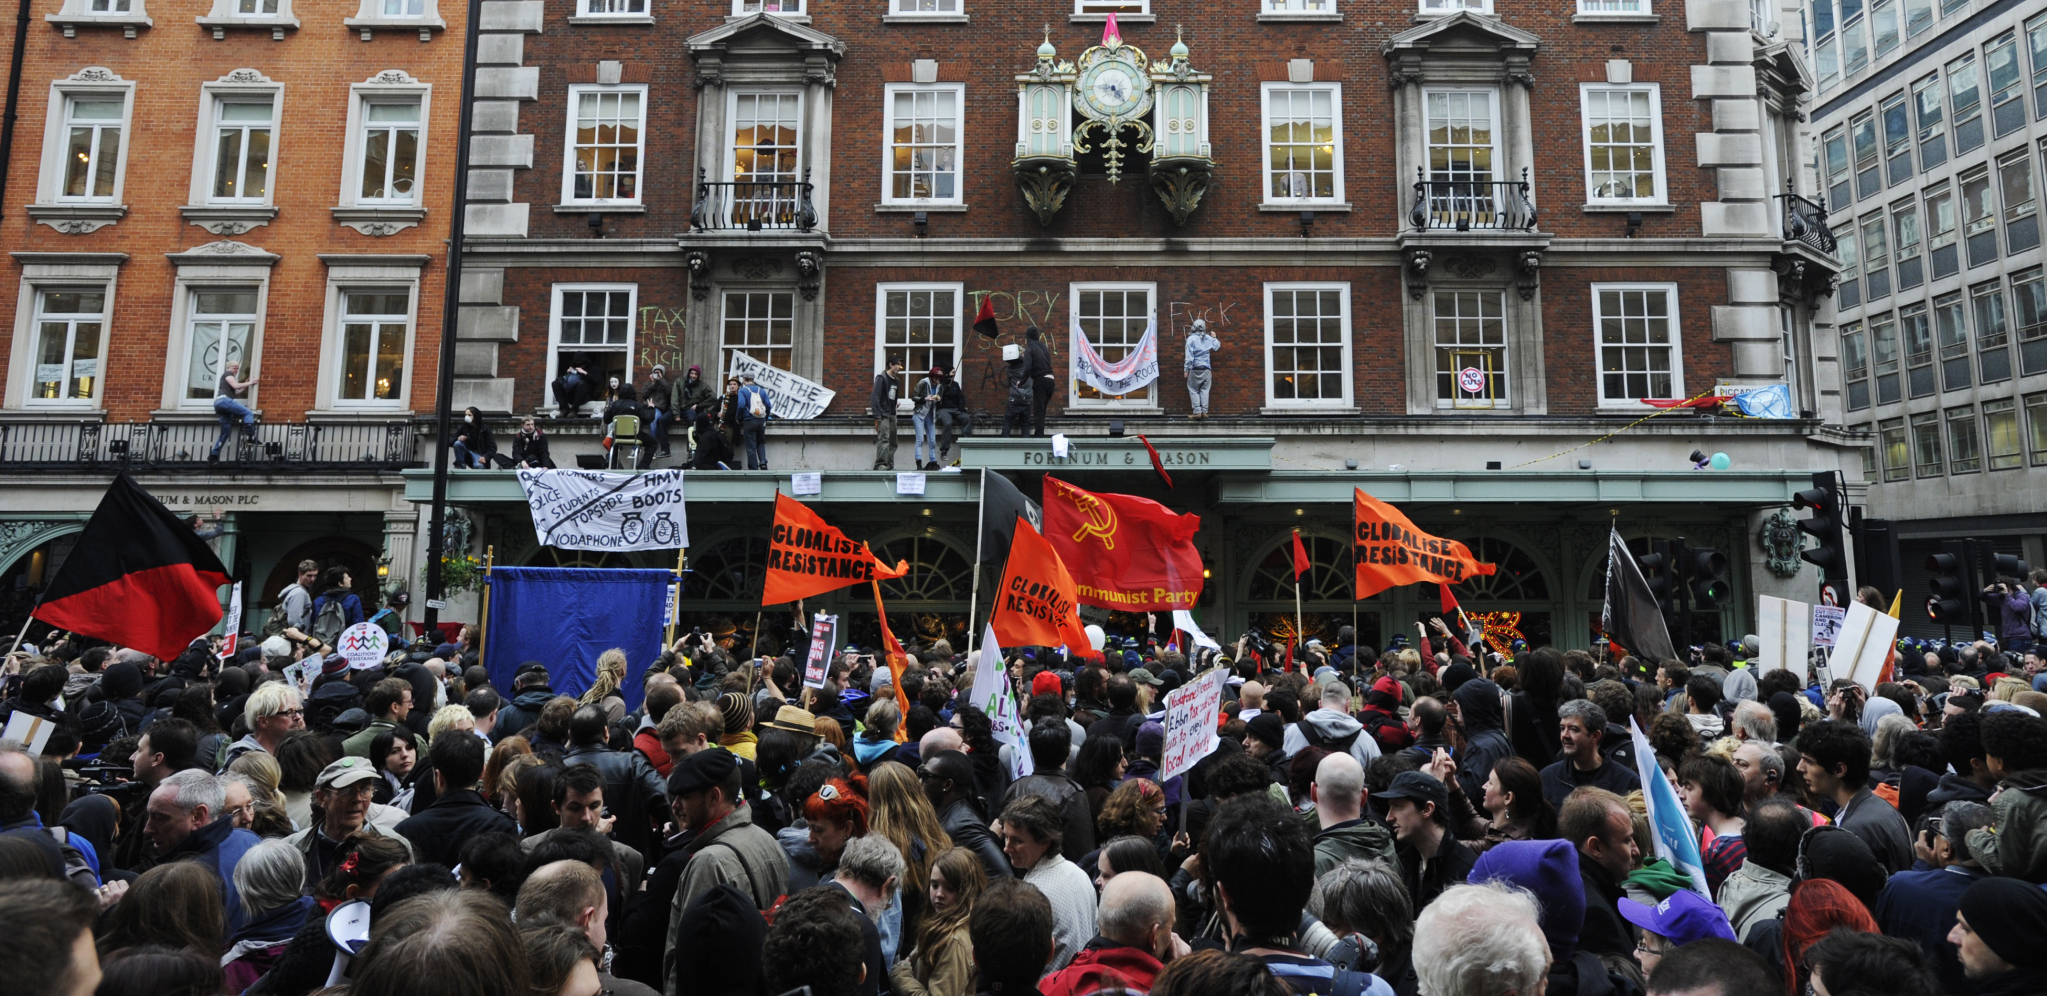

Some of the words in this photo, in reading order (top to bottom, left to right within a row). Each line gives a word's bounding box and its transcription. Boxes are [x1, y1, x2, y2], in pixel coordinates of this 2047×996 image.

[639, 306, 686, 334] TAX
[967, 290, 1059, 328] TORY
[639, 330, 681, 349] THE
[641, 347, 682, 370] RICH
[736, 357, 758, 372] WE
[757, 367, 787, 388] ARE
[790, 378, 822, 402] THE
[1104, 377, 1113, 387] TO
[1117, 376, 1132, 389] THE
[1134, 360, 1158, 382] ROOF
[1124, 452, 1134, 465] &
[1149, 452, 1210, 465] ASON
[643, 470, 682, 487] HMV
[182, 496, 190, 504] &
[194, 495, 234, 504] MASON
[237, 495, 259, 504] PLC
[551, 487, 600, 519] STUDENTS
[631, 489, 682, 508] BOOTS
[570, 493, 623, 528] TOPSHOP
[1077, 584, 1148, 604] mmunist
[1153, 587, 1198, 606] Party
[1179, 728, 1187, 744] to
[1165, 744, 1186, 776] local
